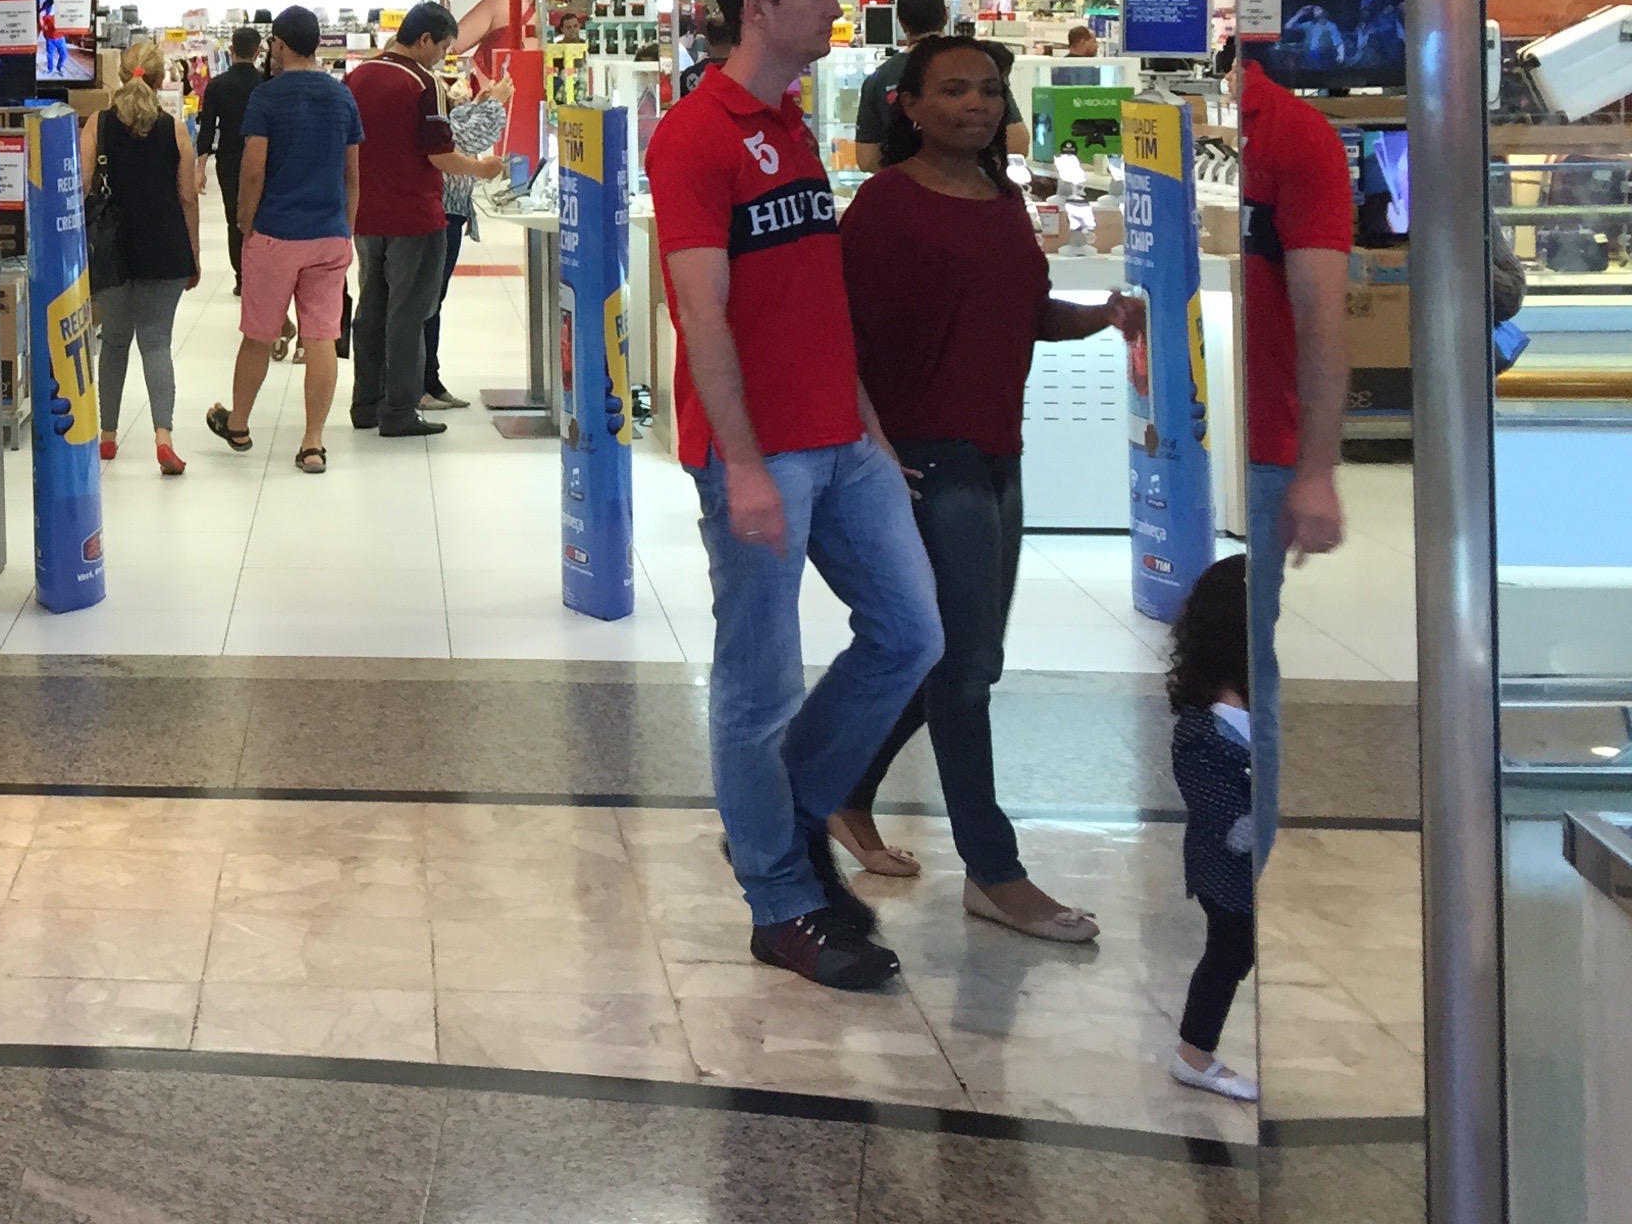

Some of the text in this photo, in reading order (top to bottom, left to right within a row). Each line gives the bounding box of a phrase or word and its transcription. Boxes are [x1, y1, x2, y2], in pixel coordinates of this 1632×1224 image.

[565, 140, 584, 163] TIM
[743, 130, 780, 175] 5
[1134, 136, 1158, 160] TIM
[1131, 231, 1154, 253] CHIP
[1155, 557, 1171, 574] TIM
